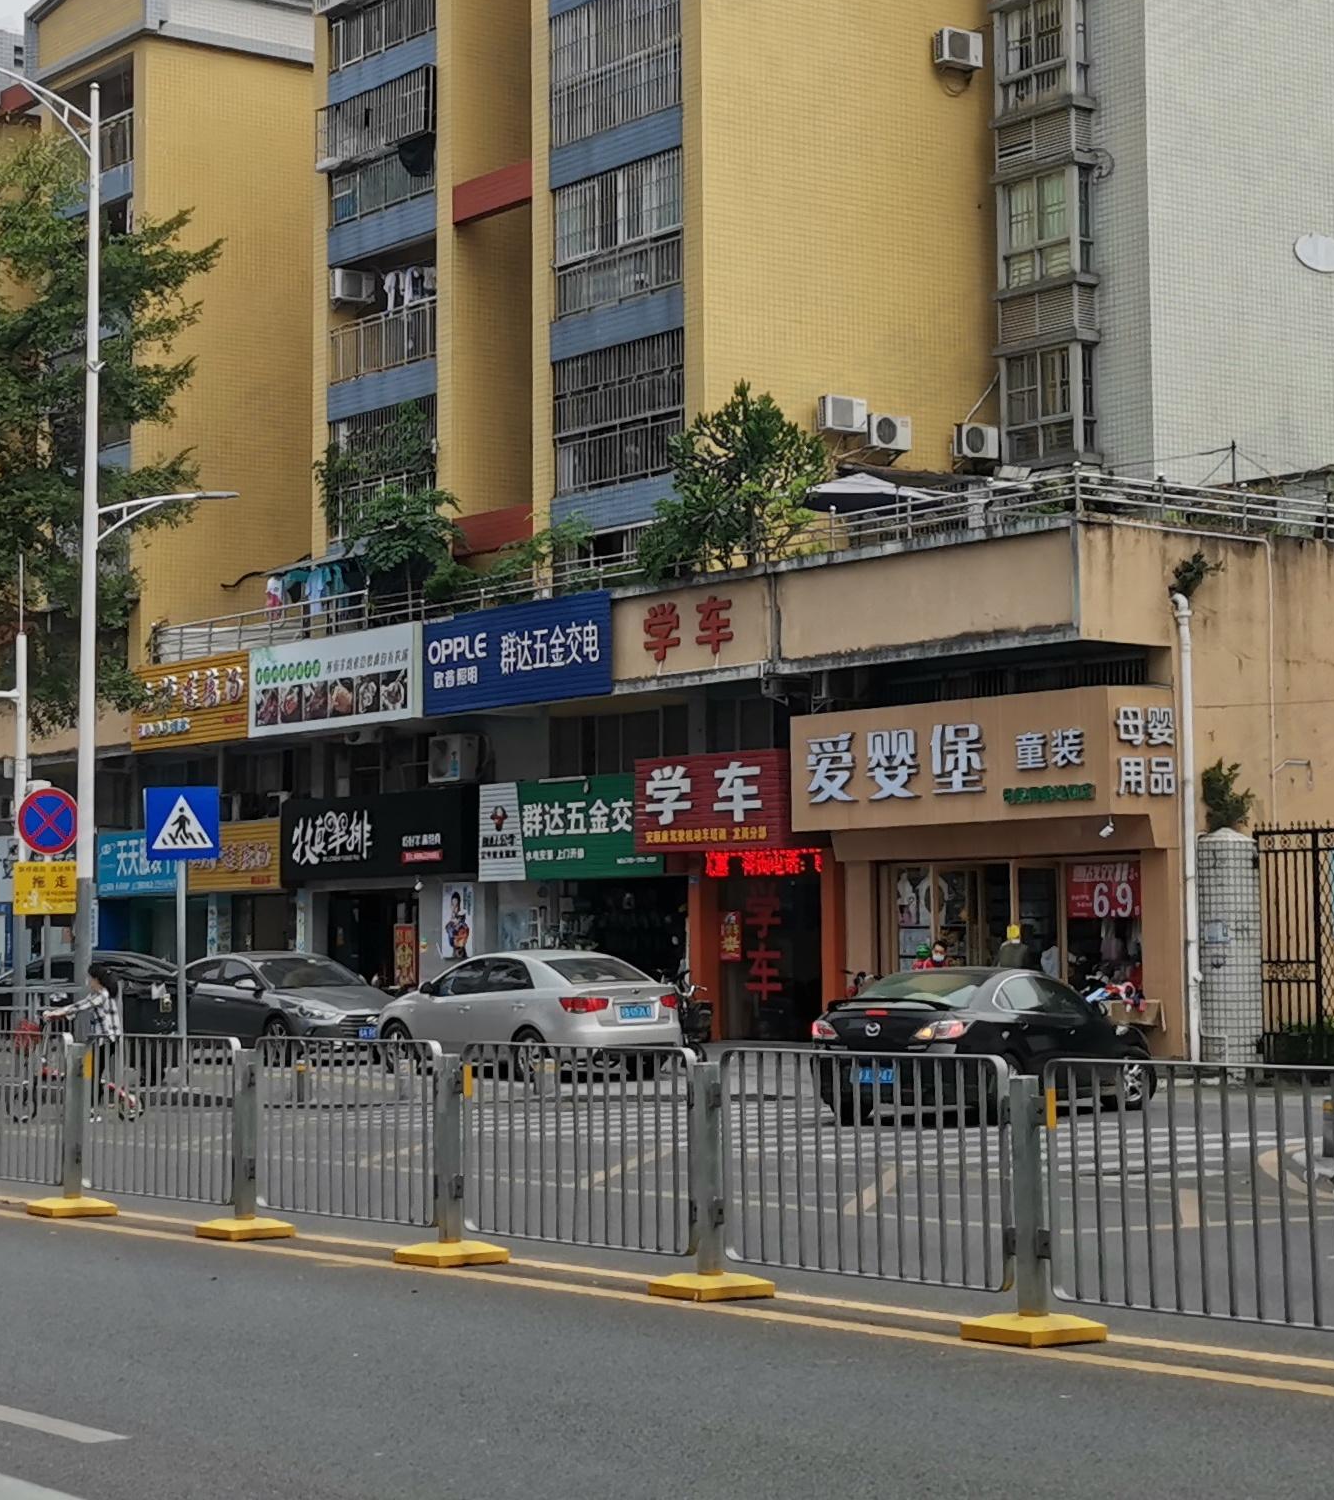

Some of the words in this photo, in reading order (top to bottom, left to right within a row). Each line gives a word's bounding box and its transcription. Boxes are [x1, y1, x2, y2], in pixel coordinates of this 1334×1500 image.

[428, 632, 487, 665] OPPLE
[500, 620, 600, 676] 群达五金交电
[643, 595, 734, 663] 学车
[433, 666, 478, 689] 欧普照明
[1116, 705, 1176, 748] 母婴
[805, 722, 987, 805] 爱婴堡
[1014, 729, 1086, 771] 童装
[644, 762, 763, 826] 学车
[1117, 756, 1177, 797] 用品
[522, 798, 634, 838] 群达五金交
[1093, 882, 1133, 918] 6.9
